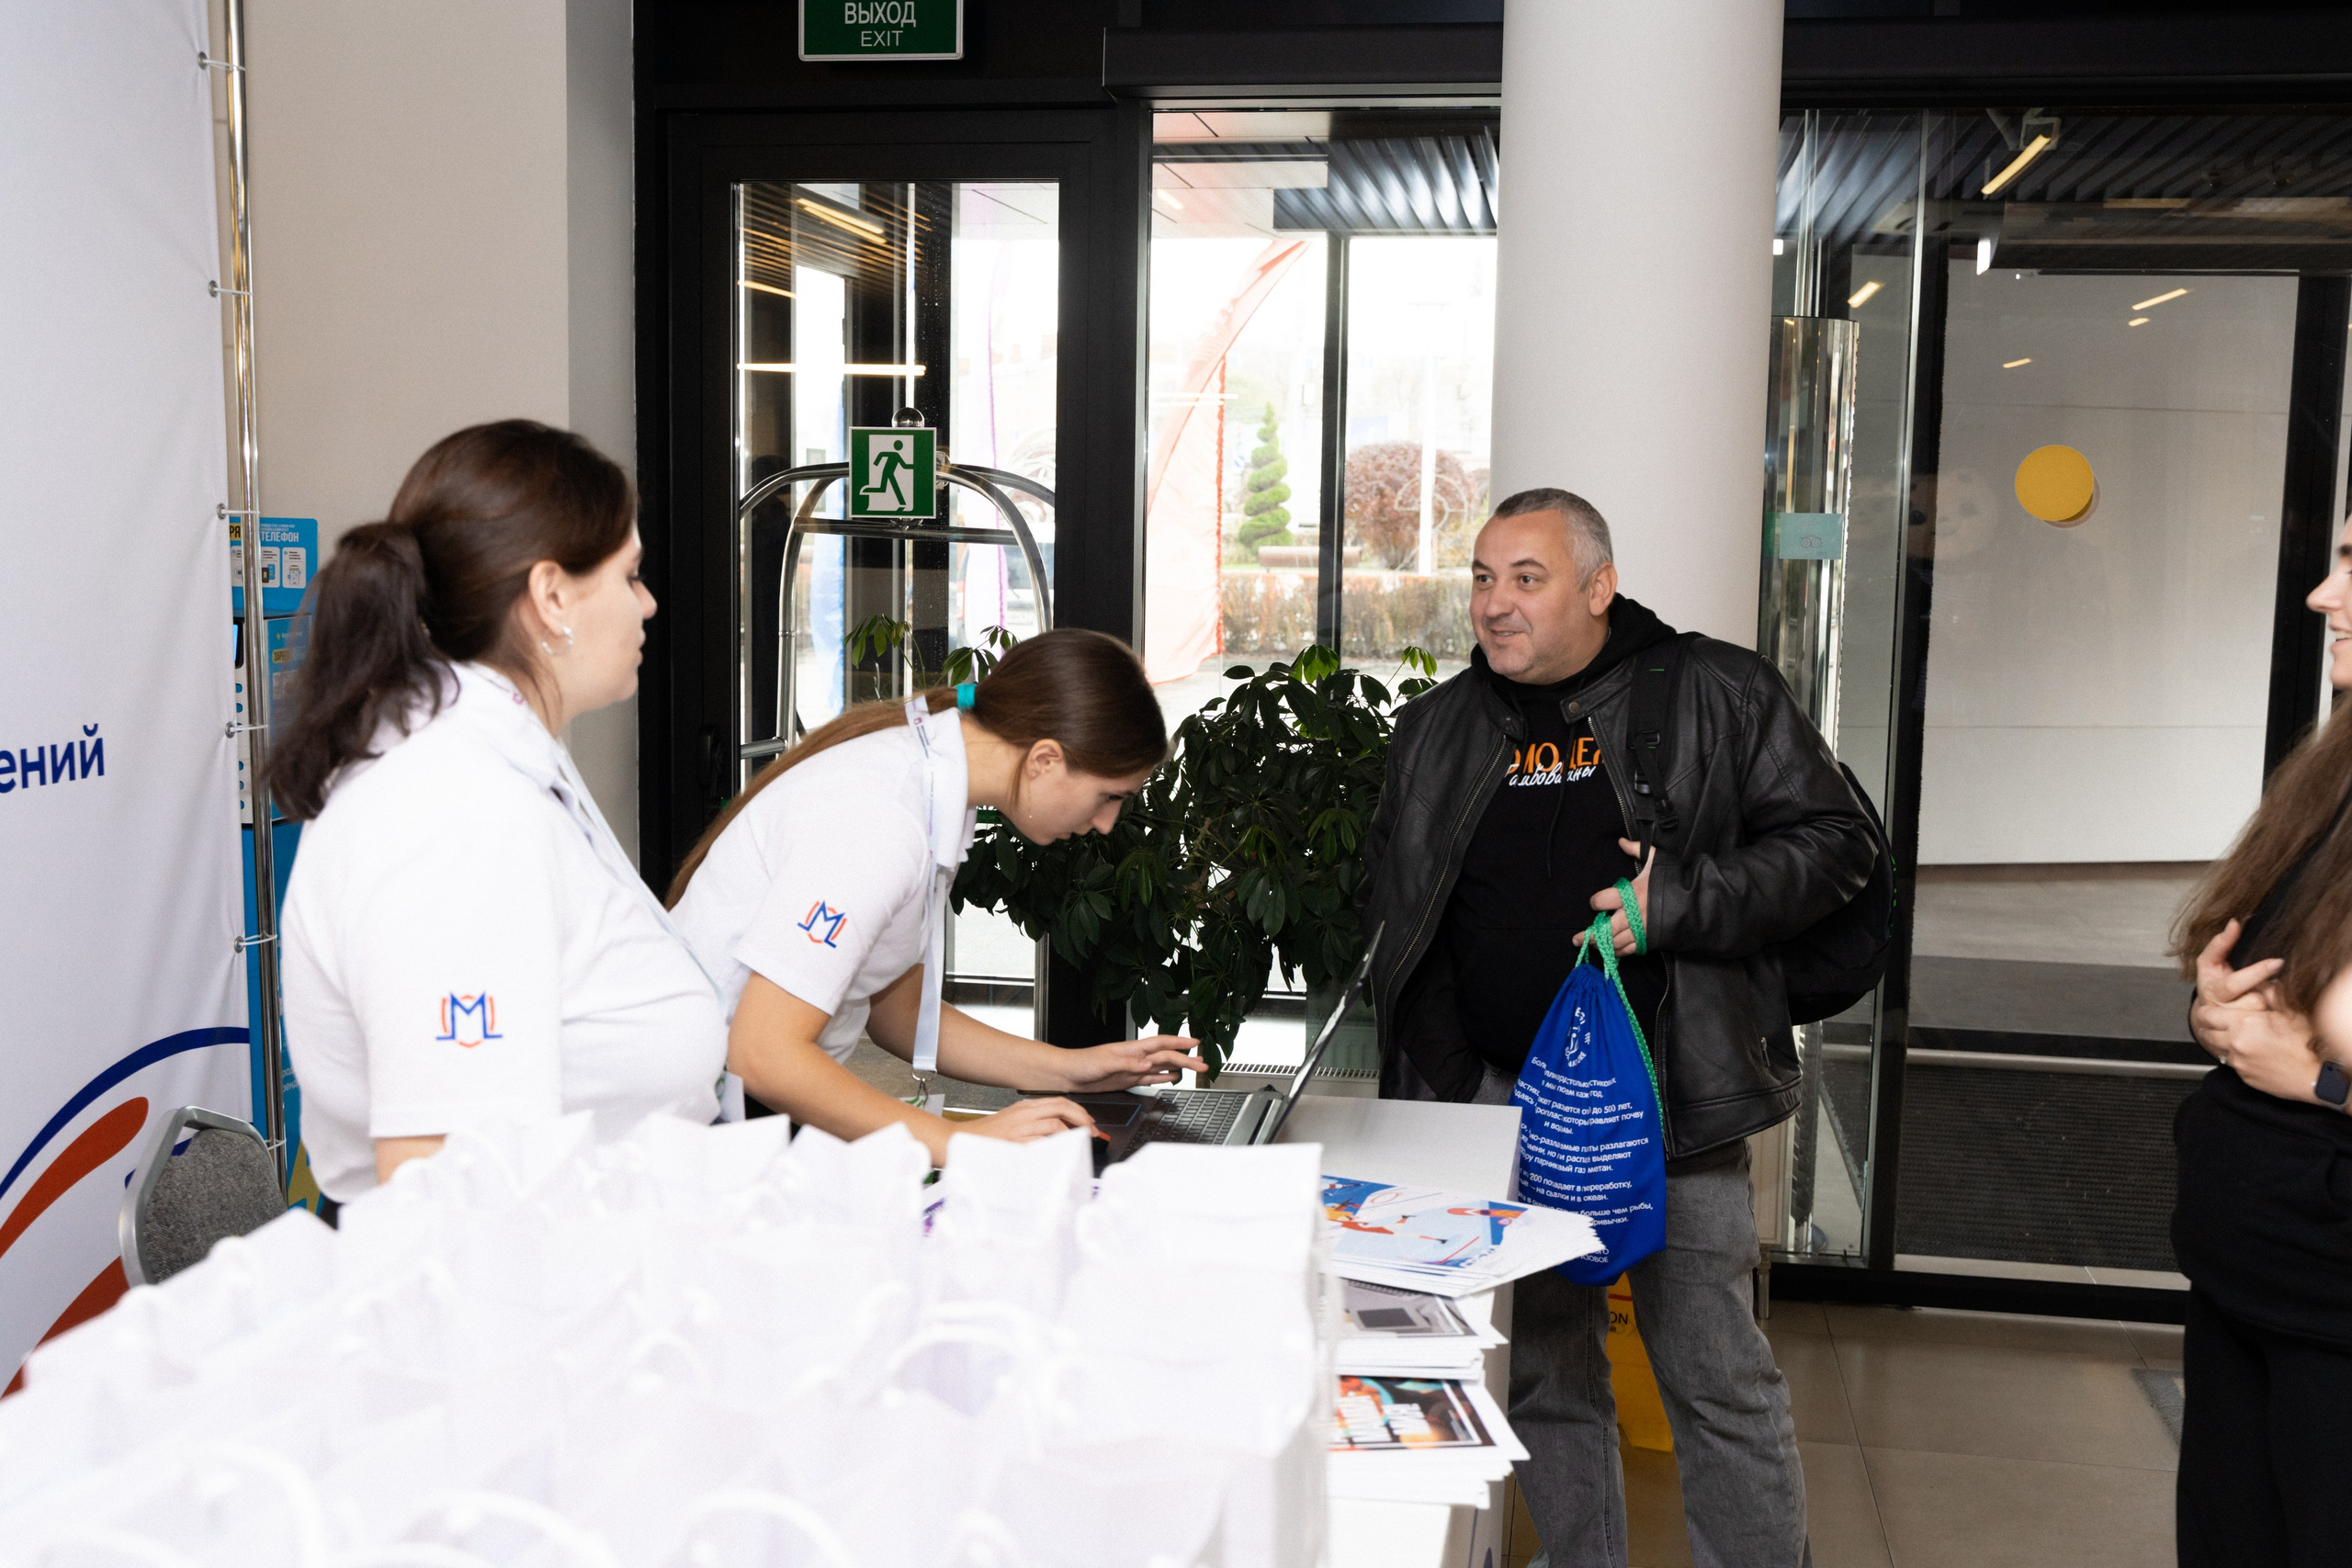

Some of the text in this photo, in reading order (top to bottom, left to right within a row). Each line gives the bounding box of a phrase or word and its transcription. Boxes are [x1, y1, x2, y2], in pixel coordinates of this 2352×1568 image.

[844, 1, 917, 28] ВЫХОД
[861, 30, 904, 47] EXIT
[260, 532, 300, 542] ТЕЛЕФОН
[1592, 1107, 1602, 1115] до
[1603, 1104, 1616, 1114] 500
[1617, 1102, 1633, 1111] лет,
[1621, 1111, 1644, 1121] почву
[1600, 1137, 1649, 1153] разлагаются
[1546, 1150, 1557, 1158] но
[1591, 1151, 1632, 1163] выделяют
[1587, 1164, 1614, 1174] метан.
[1529, 1172, 1543, 1183] 200
[1582, 1194, 1609, 1202] океан.
[1611, 1207, 1629, 1215] чем
[1629, 1201, 1654, 1213] рыбы,
